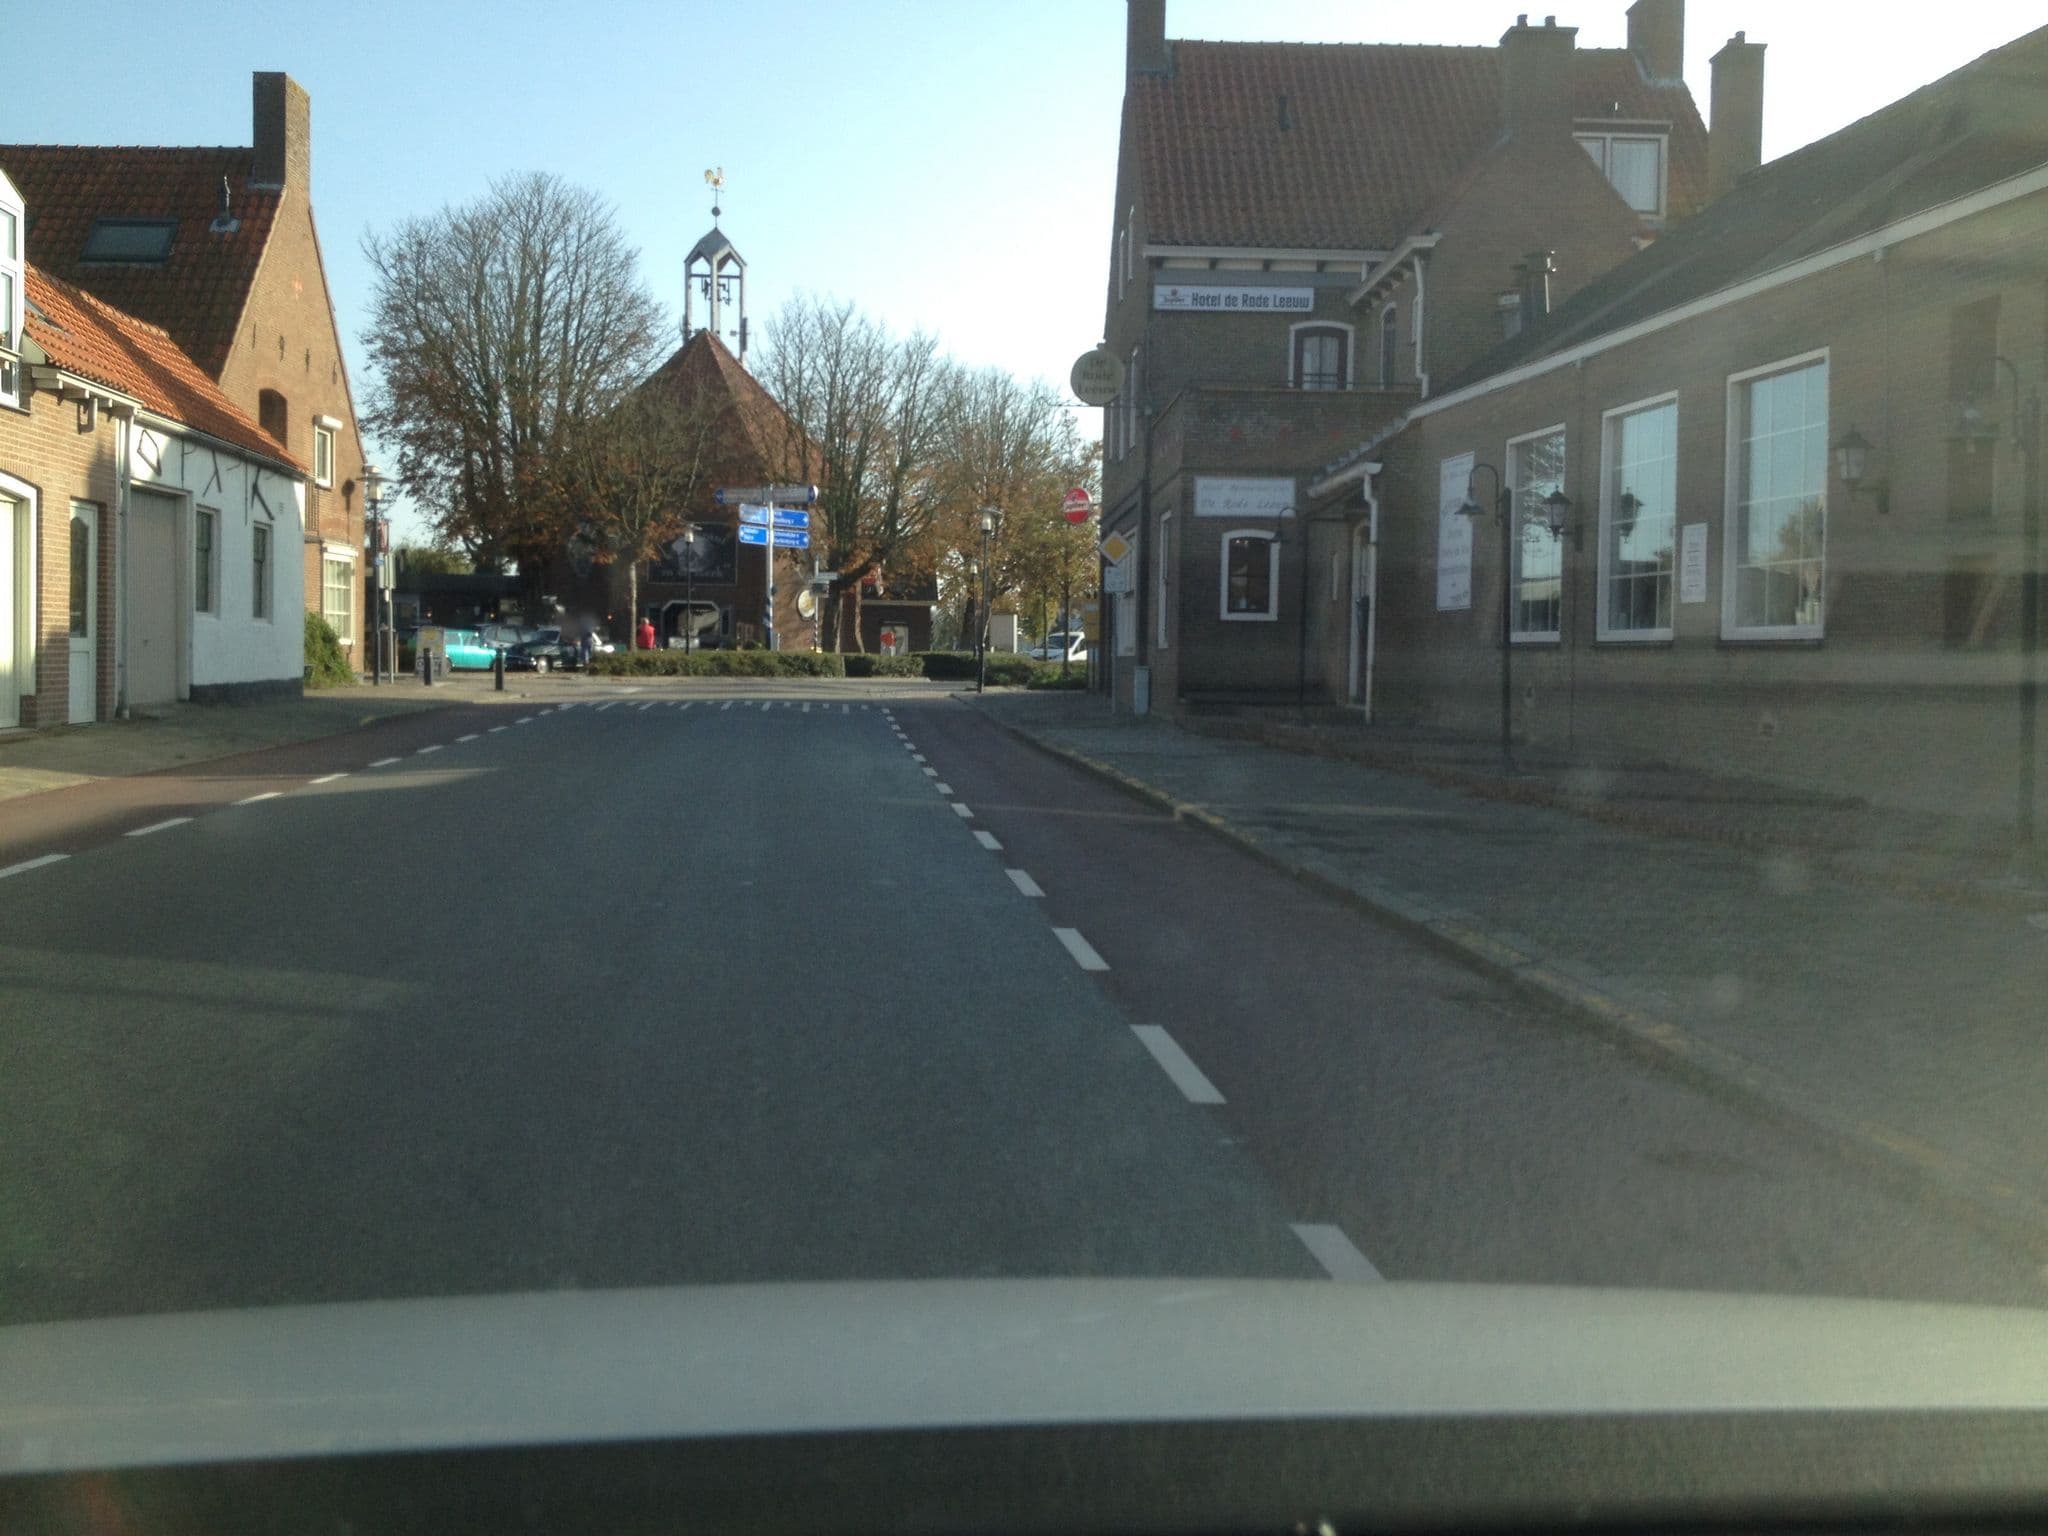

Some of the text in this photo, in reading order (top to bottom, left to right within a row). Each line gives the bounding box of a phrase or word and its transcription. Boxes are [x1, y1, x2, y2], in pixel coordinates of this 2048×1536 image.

[1191, 293, 1221, 307] Hotel
[1224, 294, 1238, 307] de
[1273, 294, 1309, 308] Leeuw
